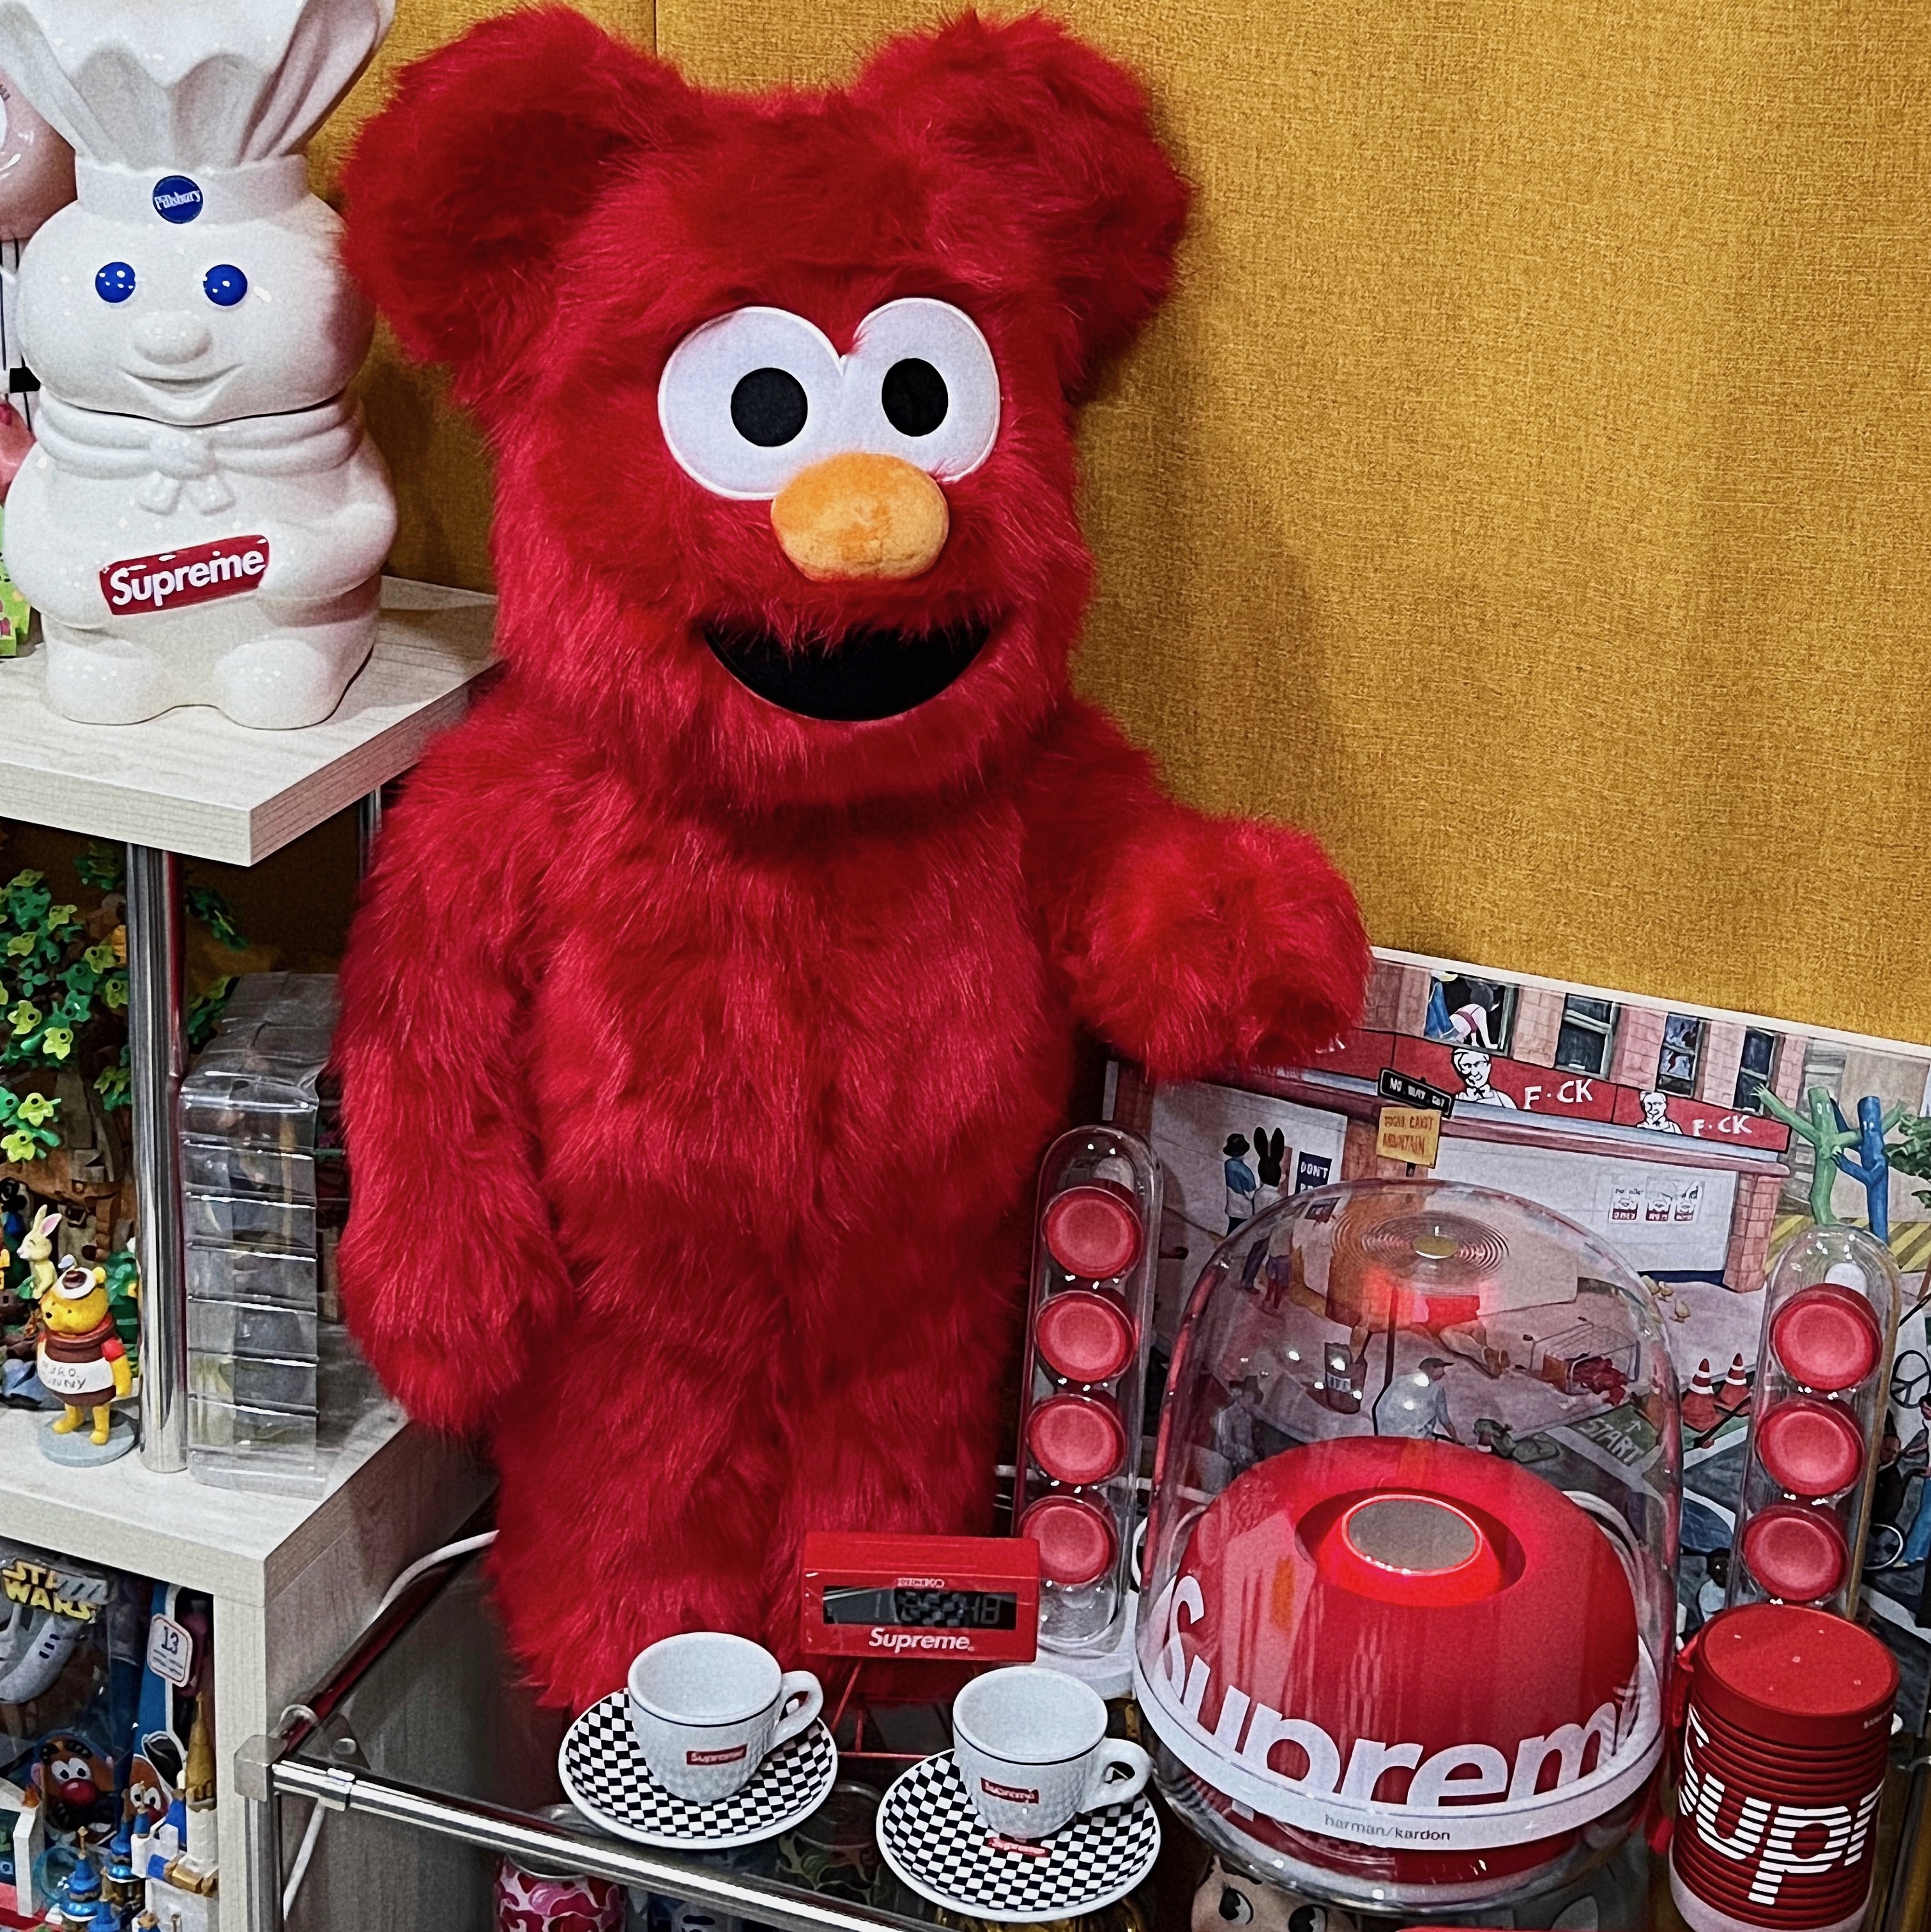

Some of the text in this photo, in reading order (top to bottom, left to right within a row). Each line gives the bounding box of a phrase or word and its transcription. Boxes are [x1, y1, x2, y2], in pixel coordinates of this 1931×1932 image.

[110, 551, 266, 607] Supreme
[1301, 1161, 1329, 1179] DON'T
[1578, 1417, 1645, 1463] START
[868, 1627, 970, 1654] Supreme
[1325, 1813, 1451, 1841] harman/kardon
